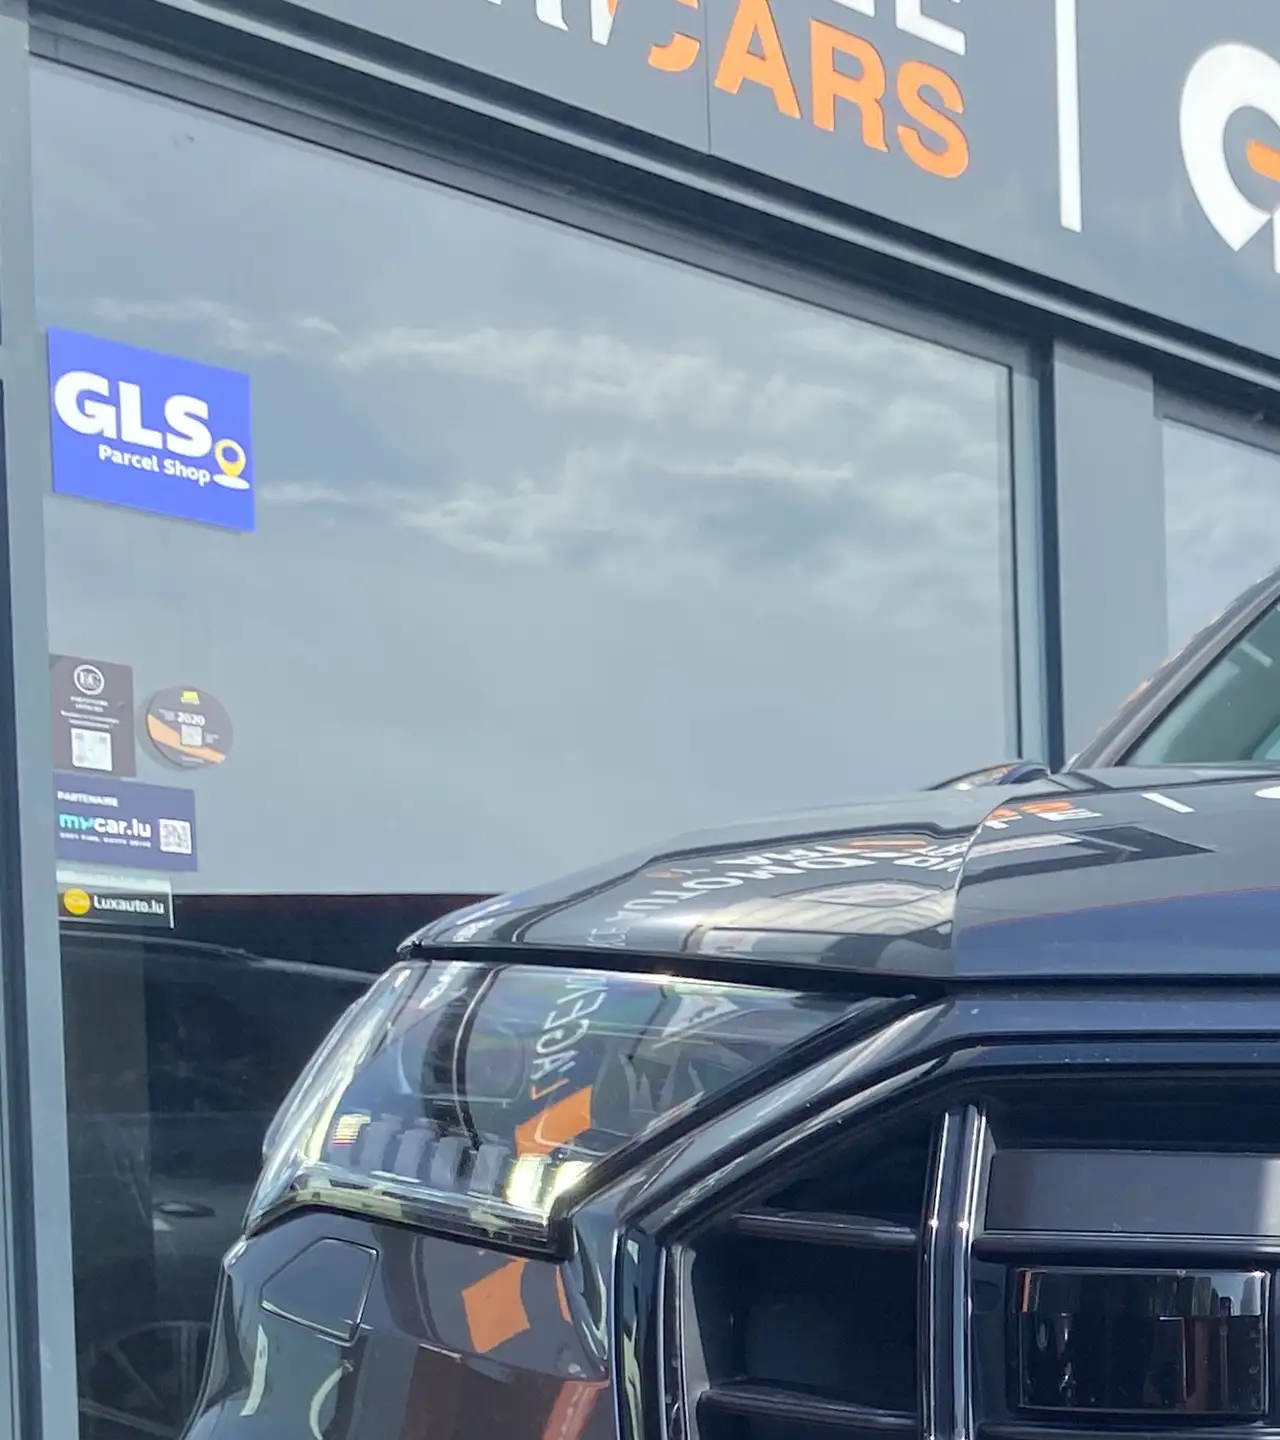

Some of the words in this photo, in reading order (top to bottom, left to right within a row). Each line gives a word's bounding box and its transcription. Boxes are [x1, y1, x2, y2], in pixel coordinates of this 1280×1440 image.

[55, 370, 213, 457] GLS
[99, 444, 159, 472] Parcel
[163, 459, 211, 487] Shop
[177, 711, 206, 727] 2020
[93, 894, 165, 915] Luxauto.lu
